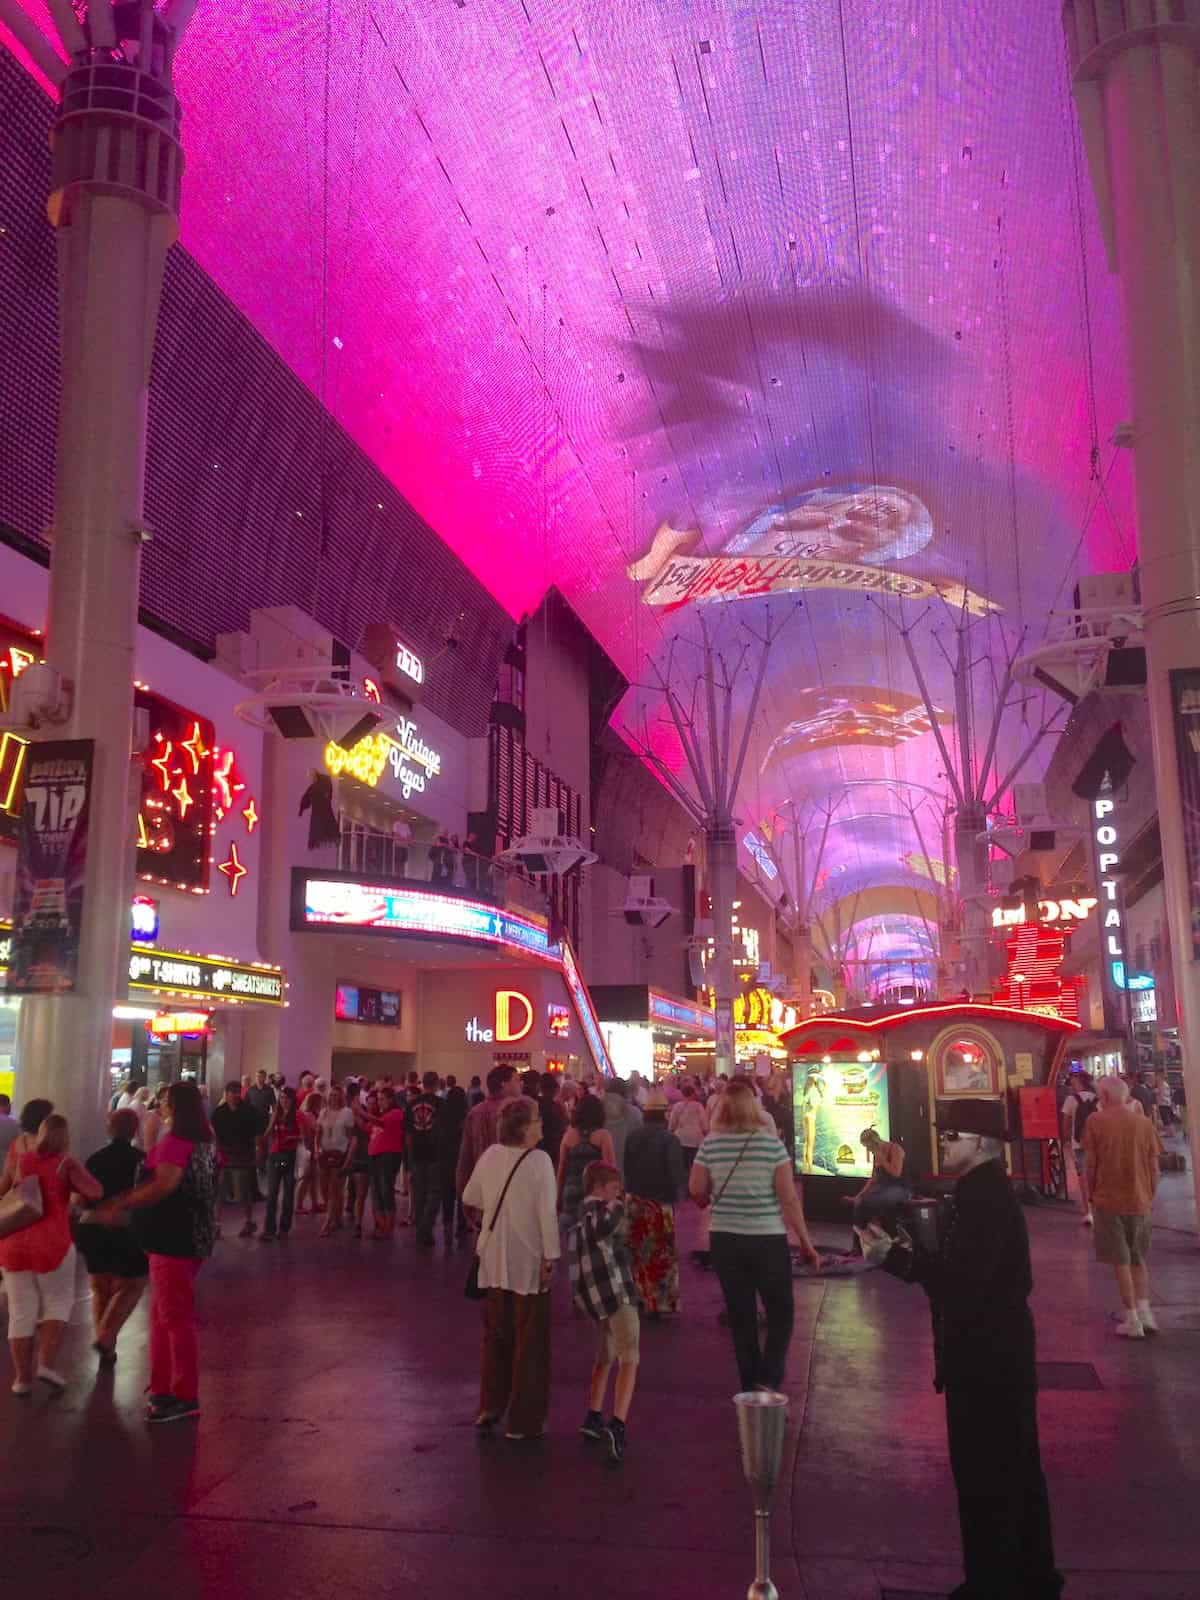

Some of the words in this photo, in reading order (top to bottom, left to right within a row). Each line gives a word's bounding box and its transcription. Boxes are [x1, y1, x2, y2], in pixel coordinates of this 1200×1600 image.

[396, 715, 441, 774] Vintage
[389, 745, 426, 799] Vegas
[24, 784, 87, 832] ZIP
[152, 959, 201, 987] T-SHIRTS
[465, 1017, 494, 1043] the
[495, 990, 535, 1042] D
